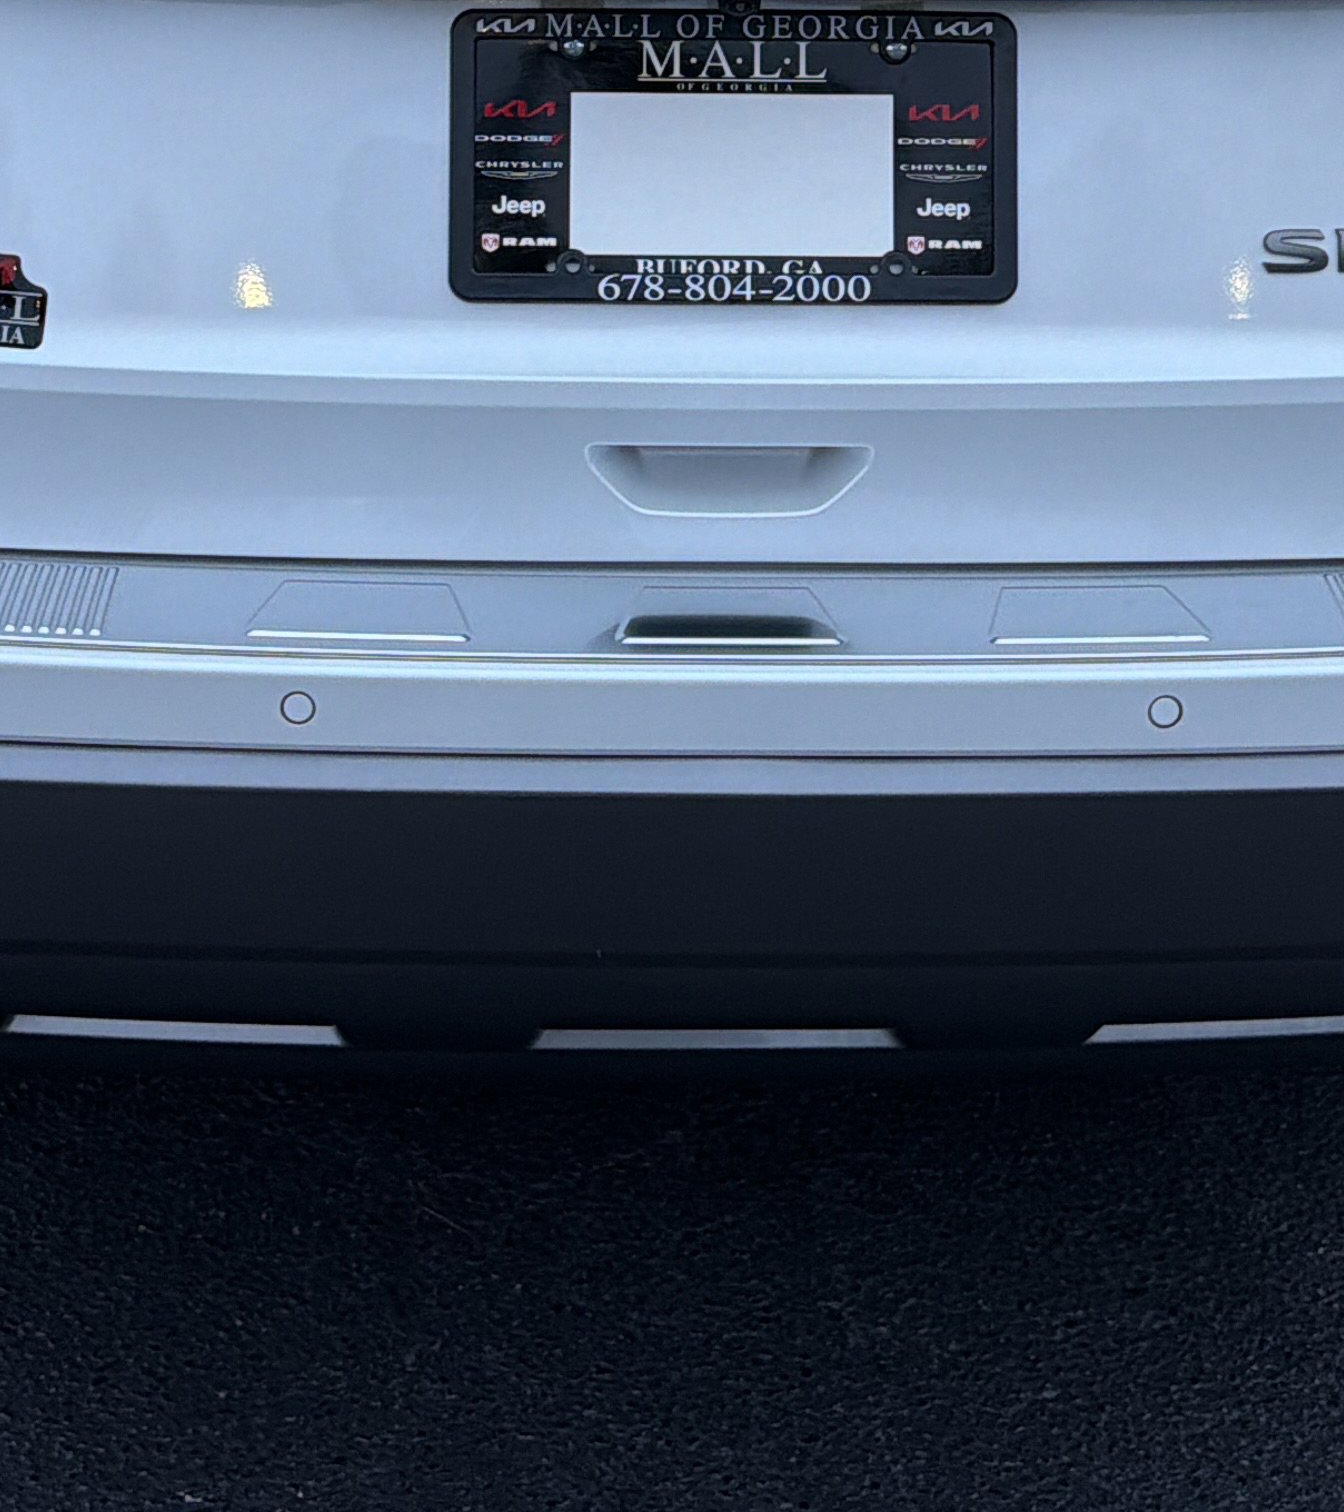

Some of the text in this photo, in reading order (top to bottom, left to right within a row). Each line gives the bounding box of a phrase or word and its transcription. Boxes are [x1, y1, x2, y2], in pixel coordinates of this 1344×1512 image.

[476, 18, 535, 33] KIA
[676, 14, 725, 38] OF
[742, 14, 925, 39] GEORGIA
[934, 20, 993, 36] KIA
[677, 83, 793, 92] OF GEORGIA
[484, 100, 557, 118] KIA
[909, 104, 980, 121] KIA
[474, 135, 553, 143] DODGE
[897, 138, 977, 146] DODGE
[475, 161, 563, 169] CHRYSLER
[899, 164, 987, 172] CHRYSLER
[491, 195, 545, 217] Jeep
[916, 198, 970, 220] Jeep
[502, 237, 557, 247] RAM
[928, 240, 983, 250] RAM
[781, 259, 824, 275] GA
[597, 274, 872, 302] 678-804-2000
